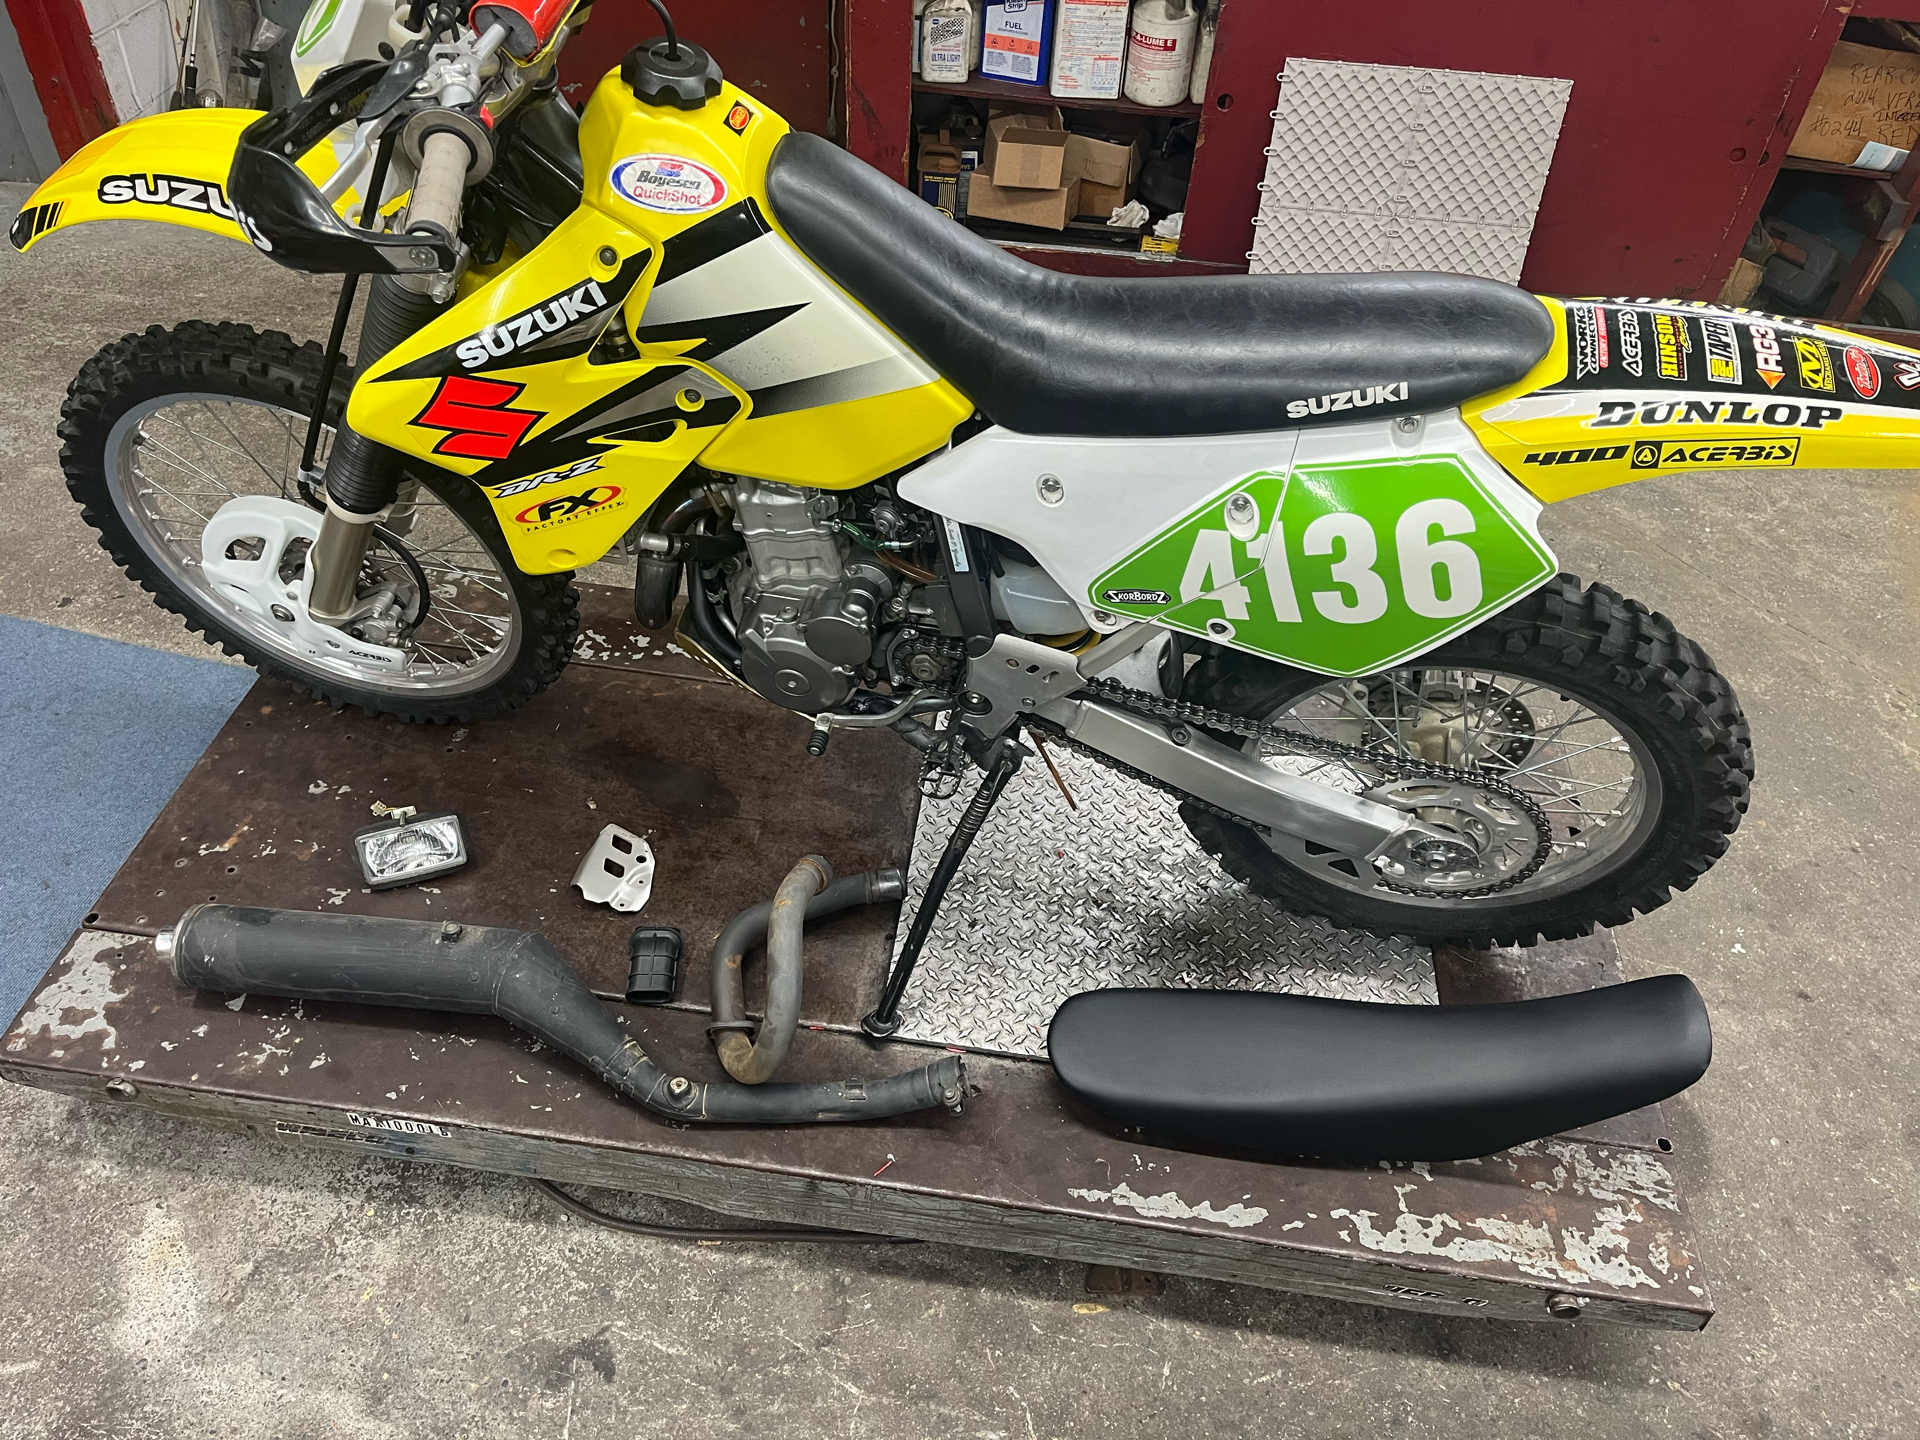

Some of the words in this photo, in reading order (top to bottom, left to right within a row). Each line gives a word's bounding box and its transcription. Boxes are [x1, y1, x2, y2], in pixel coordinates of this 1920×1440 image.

[1005, 21, 1023, 31] FUEL
[931, 53, 946, 62] ULTRA
[1850, 63, 1897, 85] REAR
[1843, 87, 1879, 107] 2014
[633, 185, 703, 205] QuickShot
[636, 170, 702, 190] Boyesen
[101, 179, 235, 218] SUZU
[455, 281, 608, 369] SUZUKI
[1576, 306, 1592, 378] WORKS
[1705, 320, 1733, 361] TAPER
[1656, 314, 1679, 378] HINSON
[1750, 325, 1784, 372] RG3
[1711, 358, 1734, 378] PRO
[1286, 381, 1409, 419] SUZUKI
[1588, 400, 1843, 429] DUNLOP
[1521, 445, 1632, 466] 400
[496, 455, 605, 498] DR-Z
[526, 514, 580, 533] FACTORY
[586, 500, 623, 516] EFFEX
[538, 487, 606, 522] FX
[1179, 498, 1484, 625] 4136
